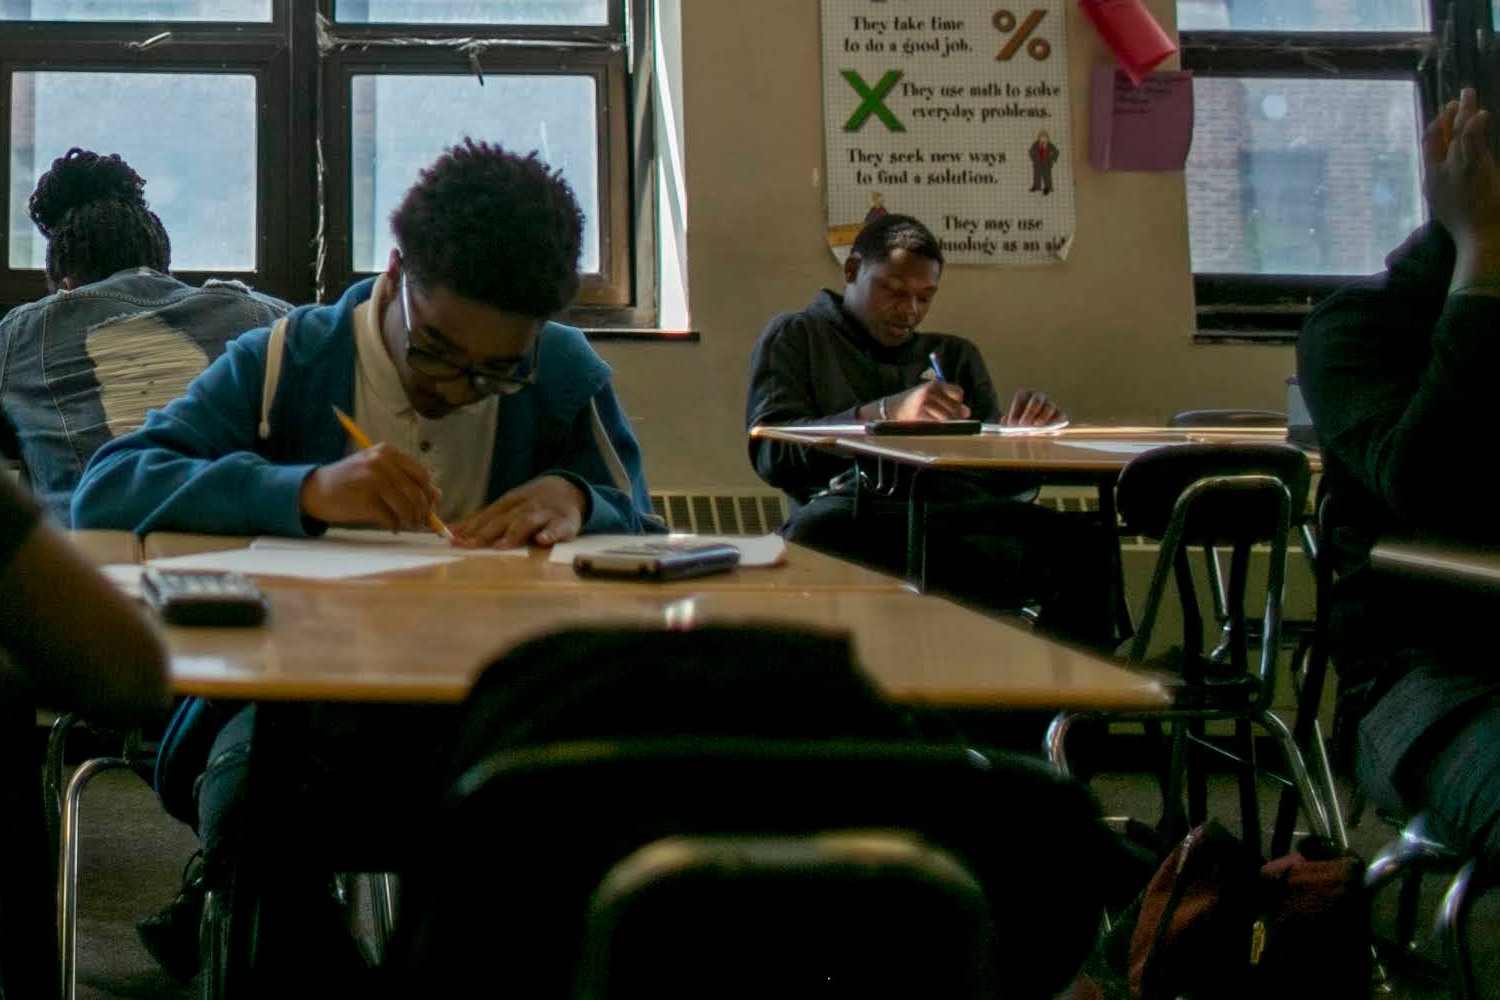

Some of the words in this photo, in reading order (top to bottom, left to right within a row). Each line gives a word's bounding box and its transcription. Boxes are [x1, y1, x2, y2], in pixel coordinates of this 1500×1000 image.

[852, 16, 888, 35] They
[894, 16, 925, 31] take
[931, 16, 965, 31] time
[844, 39, 860, 52] to
[866, 38, 884, 52] do
[889, 41, 897, 52] a
[902, 38, 940, 55] good
[941, 37, 973, 58] job.
[900, 81, 935, 101] They
[940, 84, 965, 97] use
[969, 81, 1002, 97] math
[1006, 82, 1021, 96] to
[1025, 80, 1061, 97] solve
[912, 104, 977, 123] everyday
[981, 104, 1052, 123] problems.
[847, 148, 884, 168] They
[889, 148, 924, 164] seek
[930, 151, 962, 164] new
[968, 151, 1006, 167] ways
[857, 170, 872, 185] to
[877, 170, 908, 185] find
[913, 174, 922, 185] a
[927, 169, 999, 186] solution.
[942, 215, 980, 234] They
[984, 218, 1012, 235] may
[1018, 218, 1044, 231] use
[938, 235, 997, 256] hnology
[1002, 240, 1018, 252] as
[1023, 240, 1040, 252] an
